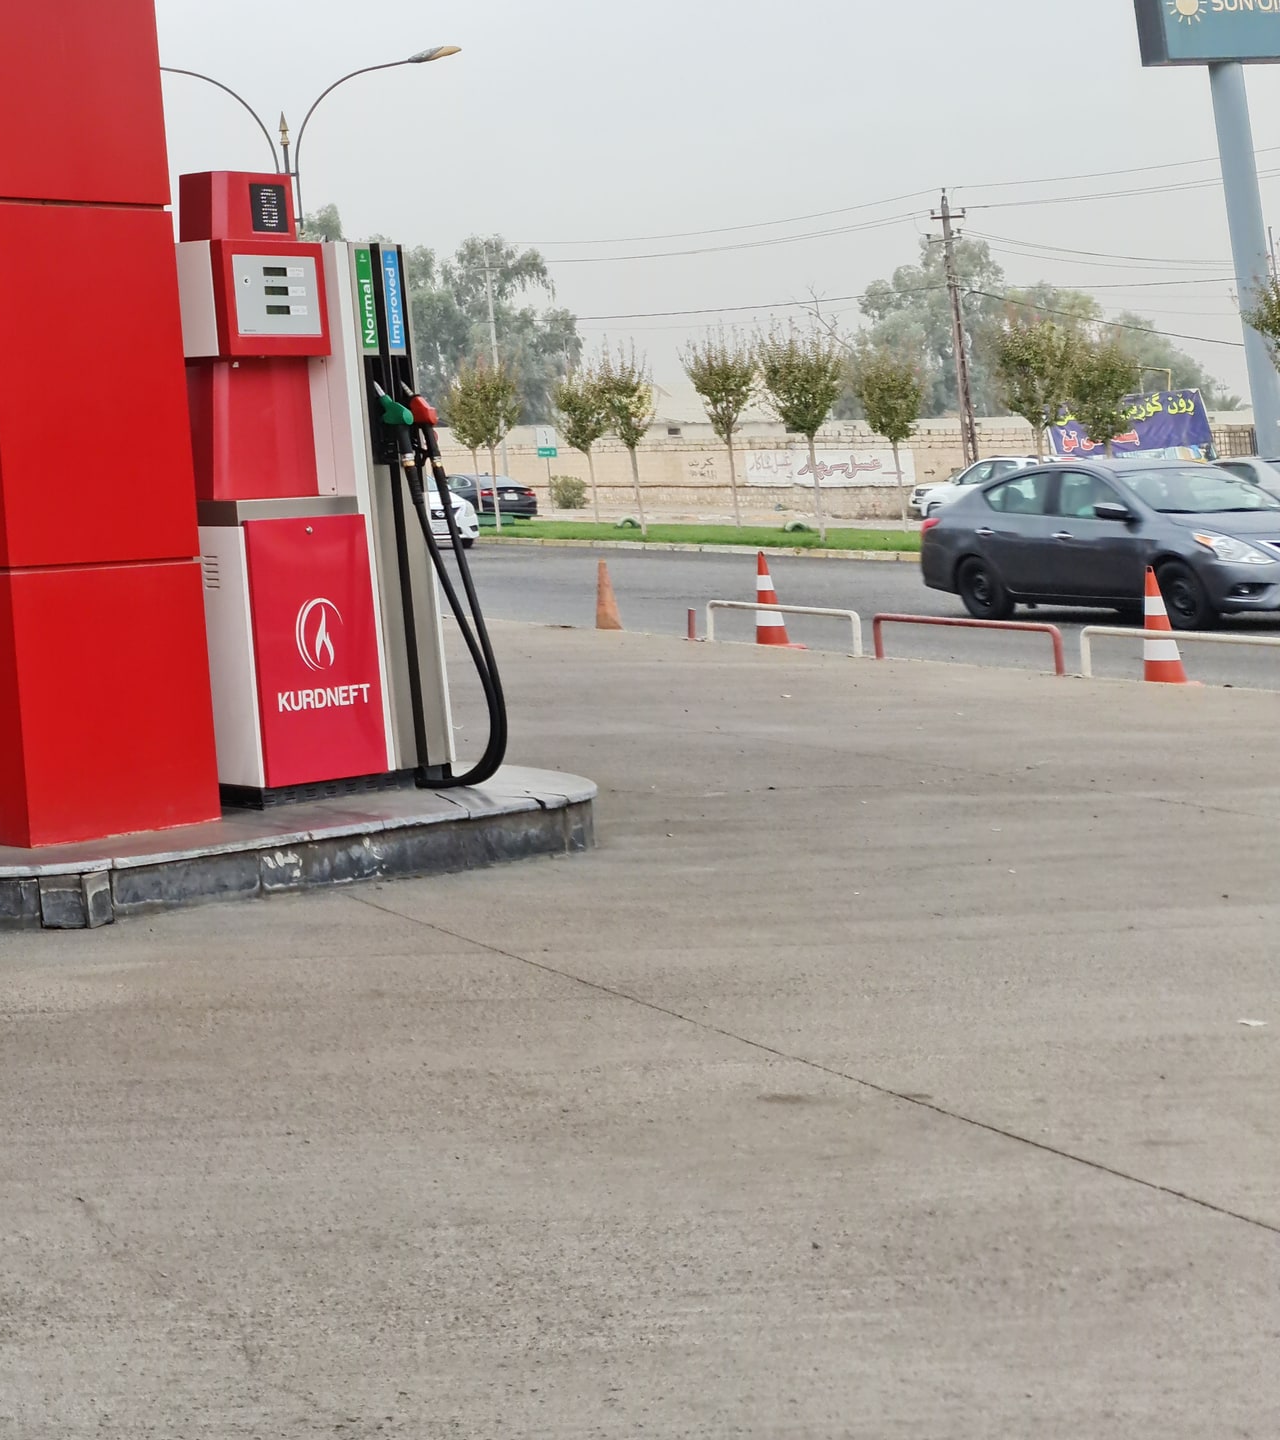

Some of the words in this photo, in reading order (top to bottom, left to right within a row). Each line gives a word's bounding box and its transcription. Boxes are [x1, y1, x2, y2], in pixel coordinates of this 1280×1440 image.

[359, 278, 376, 345] Normal
[385, 267, 401, 344] Improved
[277, 683, 371, 713] KURDNEFT
